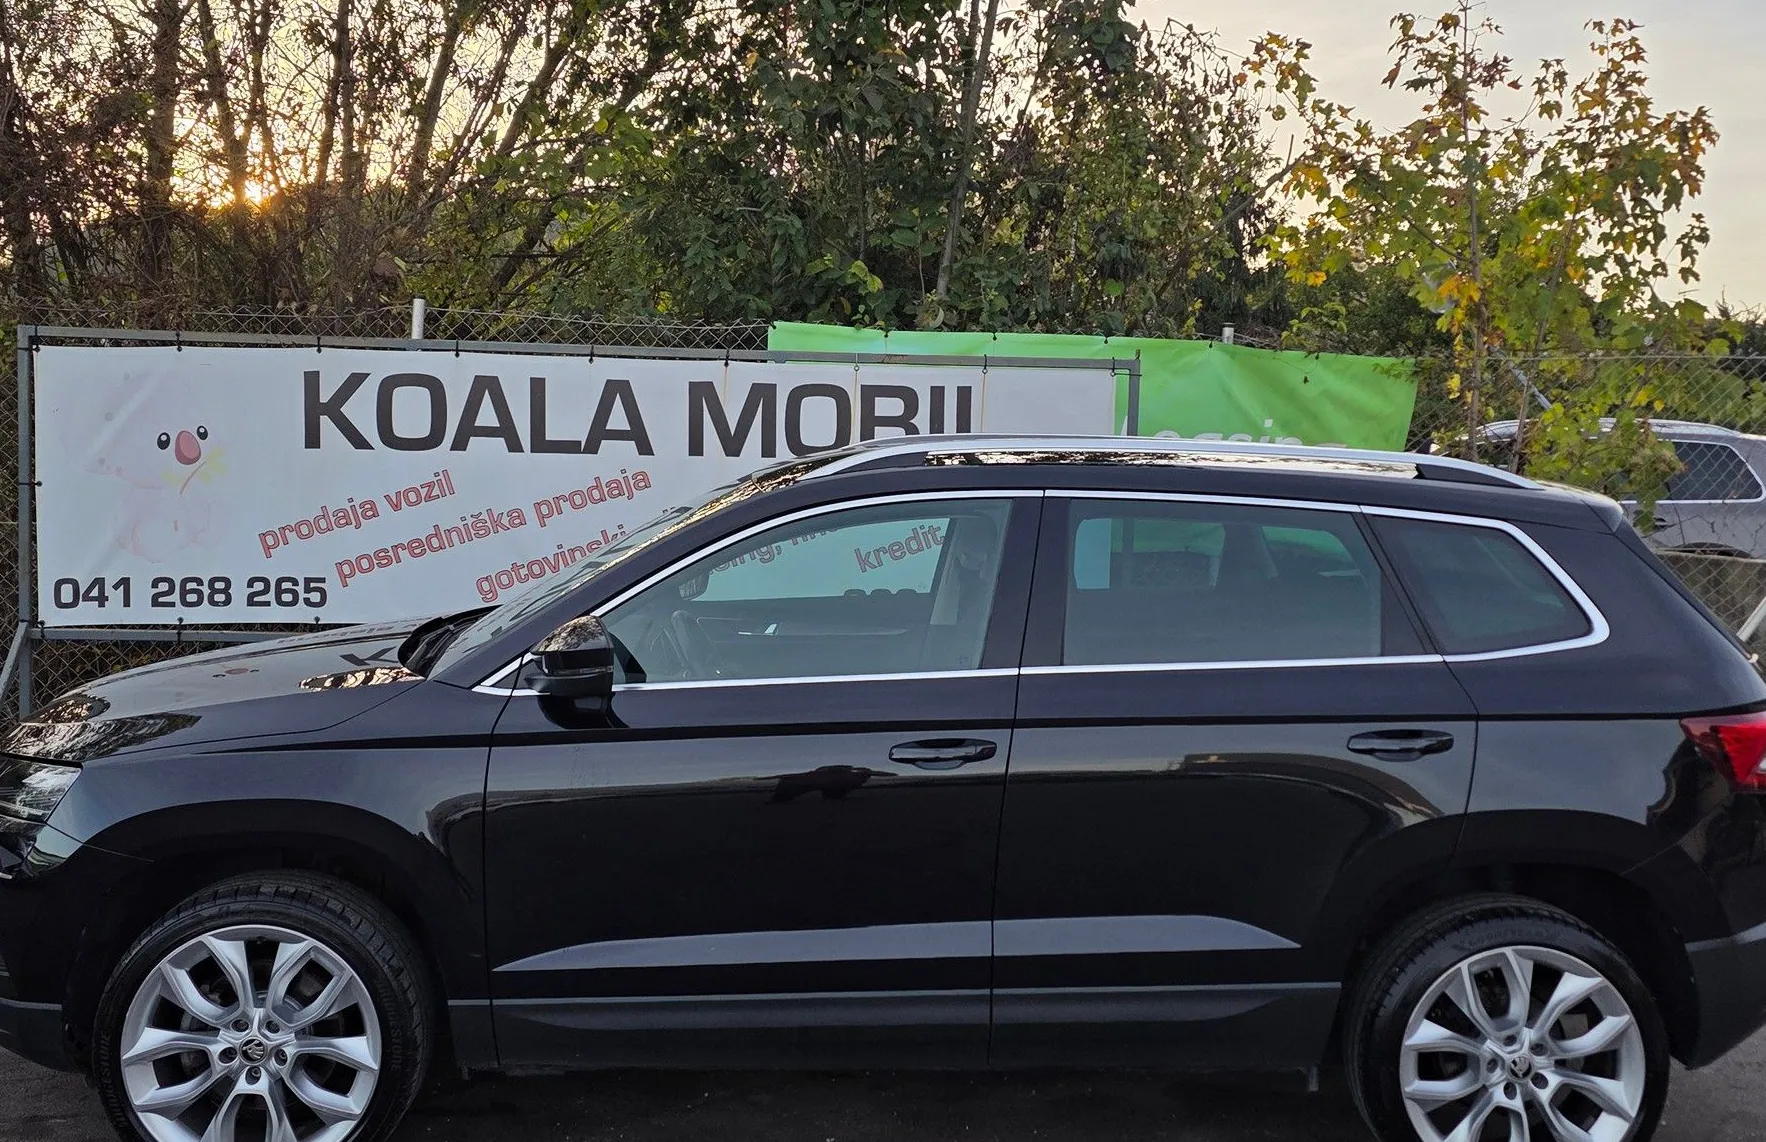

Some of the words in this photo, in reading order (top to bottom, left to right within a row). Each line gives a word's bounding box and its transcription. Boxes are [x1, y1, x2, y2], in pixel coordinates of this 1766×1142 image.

[303, 370, 656, 456] KOALA
[258, 497, 380, 558] prodaja
[383, 469, 455, 513] vozil
[334, 508, 527, 588] posredniška
[532, 467, 653, 527] prodaja
[854, 523, 945, 574] kredit
[53, 576, 131, 610] 041
[150, 576, 233, 608] 268
[246, 576, 328, 609] 265
